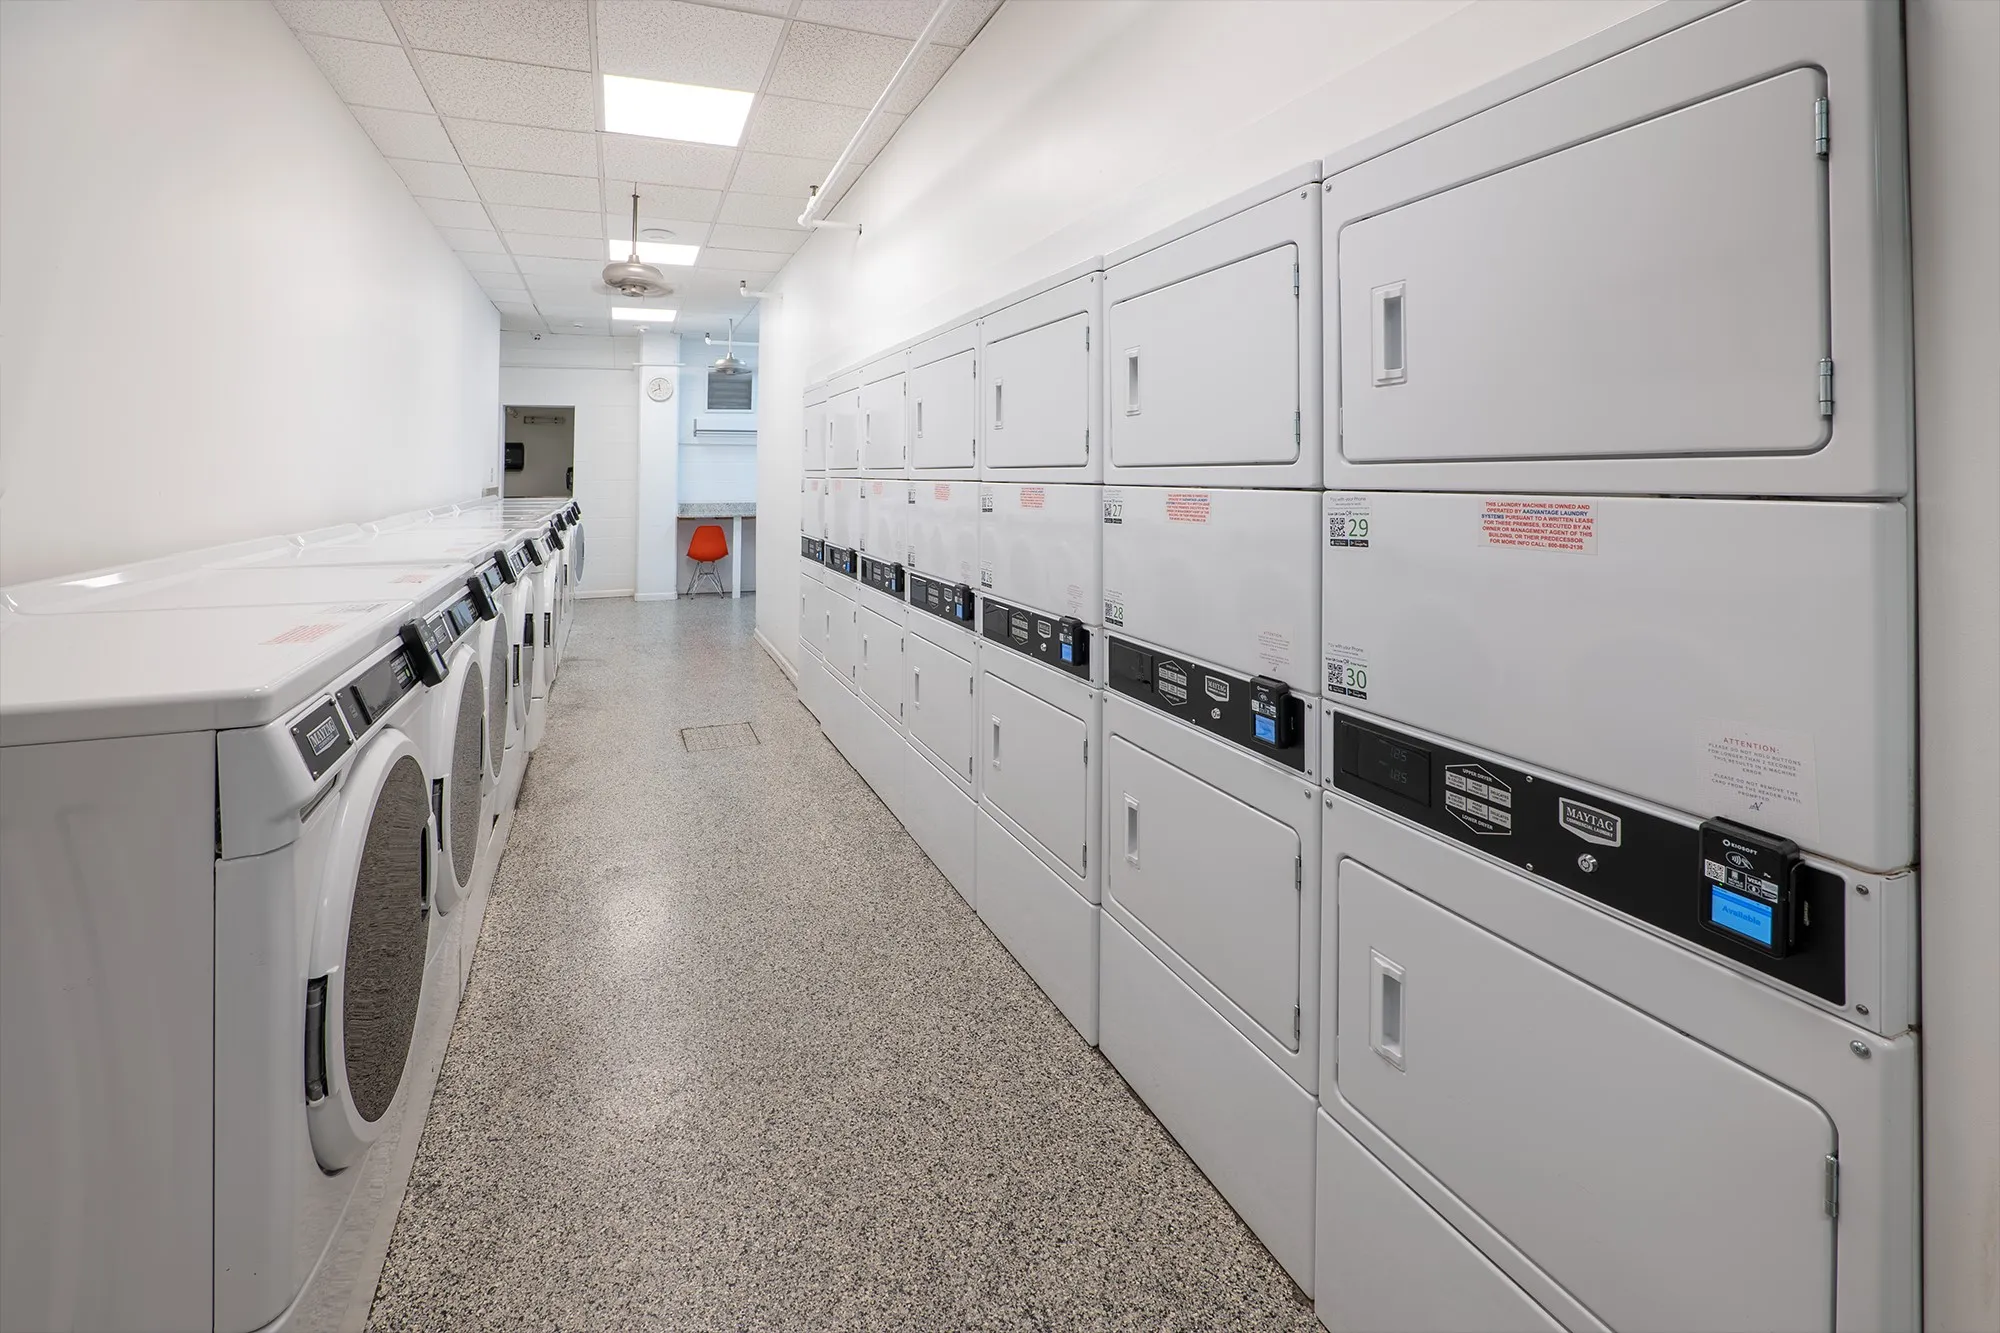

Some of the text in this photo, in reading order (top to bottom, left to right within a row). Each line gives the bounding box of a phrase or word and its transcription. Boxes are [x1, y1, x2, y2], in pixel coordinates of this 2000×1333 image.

[1112, 504, 1122, 517] 27
[1348, 518, 1368, 537] 29
[1114, 606, 1124, 620] 28
[1346, 668, 1367, 689] 30
[1724, 737, 1780, 754] ATTENTION:
[1728, 759, 1753, 768] RESULTS
[1769, 768, 1796, 776] MACHINE
[1772, 756, 1801, 766] BUTTONS
[1477, 773, 1492, 782] DRYER
[1758, 790, 1781, 798] READER
[1760, 784, 1784, 792] REMOVE
[1738, 791, 1770, 802] PROMPTED
[1462, 814, 1494, 830] LOWER DRYER
[1566, 806, 1613, 831] MAYTAG
[1730, 842, 1758, 856] KIOSOFT
[1748, 877, 1761, 886] VISA
[1722, 905, 1761, 926] Available
